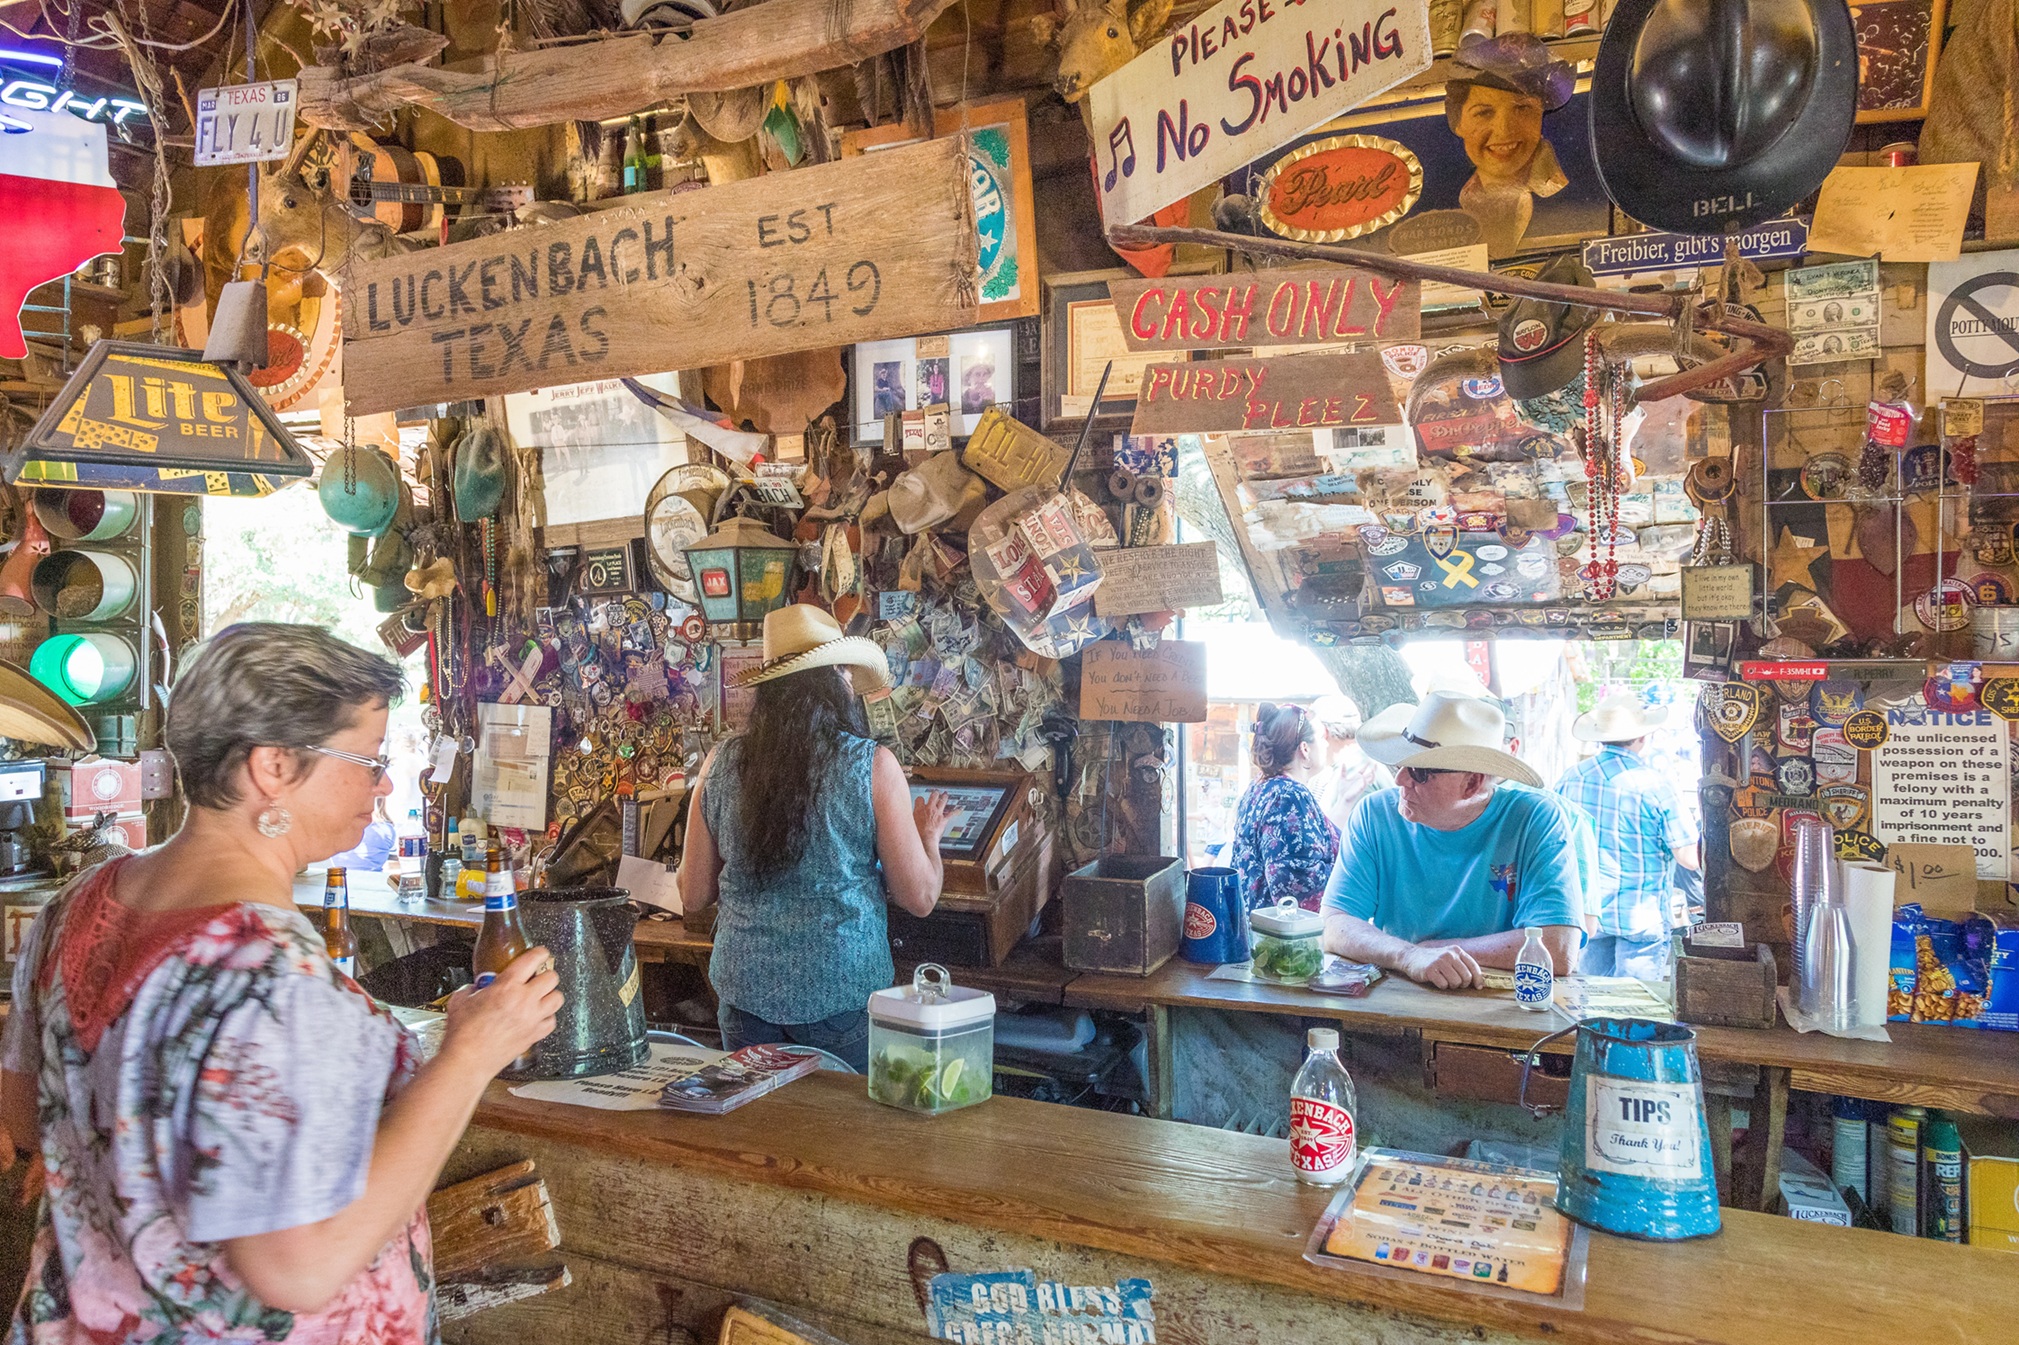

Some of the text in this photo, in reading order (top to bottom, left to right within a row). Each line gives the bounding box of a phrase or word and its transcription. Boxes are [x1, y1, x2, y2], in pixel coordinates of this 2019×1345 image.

[227, 87, 266, 106] TEXAS
[201, 100, 216, 111] MAR
[200, 109, 288, 154] FLY 4 U
[1157, 99, 1210, 173] No
[1282, 162, 1398, 216] Pearl
[1694, 192, 1762, 217] BELL
[757, 203, 837, 248] EST
[1600, 229, 1792, 264] Freibier, gibt's morgen
[368, 215, 677, 332] LUCKENBACH
[747, 260, 881, 328] 1849
[1130, 276, 1406, 343] CASH ONLY
[1951, 317, 1988, 335] POTTY
[432, 305, 610, 384] TEXAS
[1148, 366, 1269, 402] PURDY
[551, 388, 575, 401] JERRY
[576, 385, 596, 398] JEFF
[103, 374, 238, 430] Lite
[1242, 394, 1378, 430] PLEEZ
[180, 423, 239, 439] BEER
[905, 428, 923, 438] TEXAS
[1160, 548, 1177, 558] THE
[1180, 548, 1206, 559] RIGHT
[1170, 561, 1179, 569] TO
[706, 575, 726, 587] JAX
[1718, 574, 1727, 583] my
[1728, 574, 1740, 582] own
[1699, 583, 1715, 592] little
[609, 604, 624, 612] ROUTE
[1688, 604, 1728, 614] they know me
[611, 613, 623, 624] 66
[1086, 648, 1102, 665] IF
[1171, 672, 1178, 681] A
[1986, 689, 1997, 702] LOS
[1152, 703, 1161, 714] A
[1888, 709, 1993, 726] NTICE
[1849, 722, 1883, 733] BORDER
[1850, 732, 1883, 742] PATROL
[1917, 733, 1997, 743] unlicensed
[1882, 747, 1999, 757] possession of a
[1880, 760, 2003, 770] weapon on these
[1892, 772, 1990, 782] premises is a
[1893, 784, 1989, 796] felony with a
[88, 803, 125, 812] WOODBRIDGE
[1769, 796, 1819, 810] MEDRANO
[1880, 797, 2004, 809] maximum penalty
[1742, 807, 1768, 817] POLICE
[1900, 809, 1983, 821] of 10 years
[1881, 821, 2004, 833] imprisonment and
[1834, 833, 1881, 853] OLICE
[1897, 834, 1986, 845] a fine not to
[1693, 923, 1739, 934] LUCKENBACH
[1518, 991, 1544, 1002] EXAS
[573, 1080, 613, 1089] Please
[1619, 1096, 1672, 1126] TIPS
[1609, 1133, 1682, 1153] Thank You!
[1292, 1152, 1335, 1171] EXAS
[1935, 1152, 1958, 1161] BONUS
[1402, 1186, 1425, 1196] ALL
[1431, 1191, 1481, 1205] OTHER
[1365, 1232, 1527, 1267] SODAS BOTTLED WATER
[971, 1282, 1124, 1316] GOD BLESS
